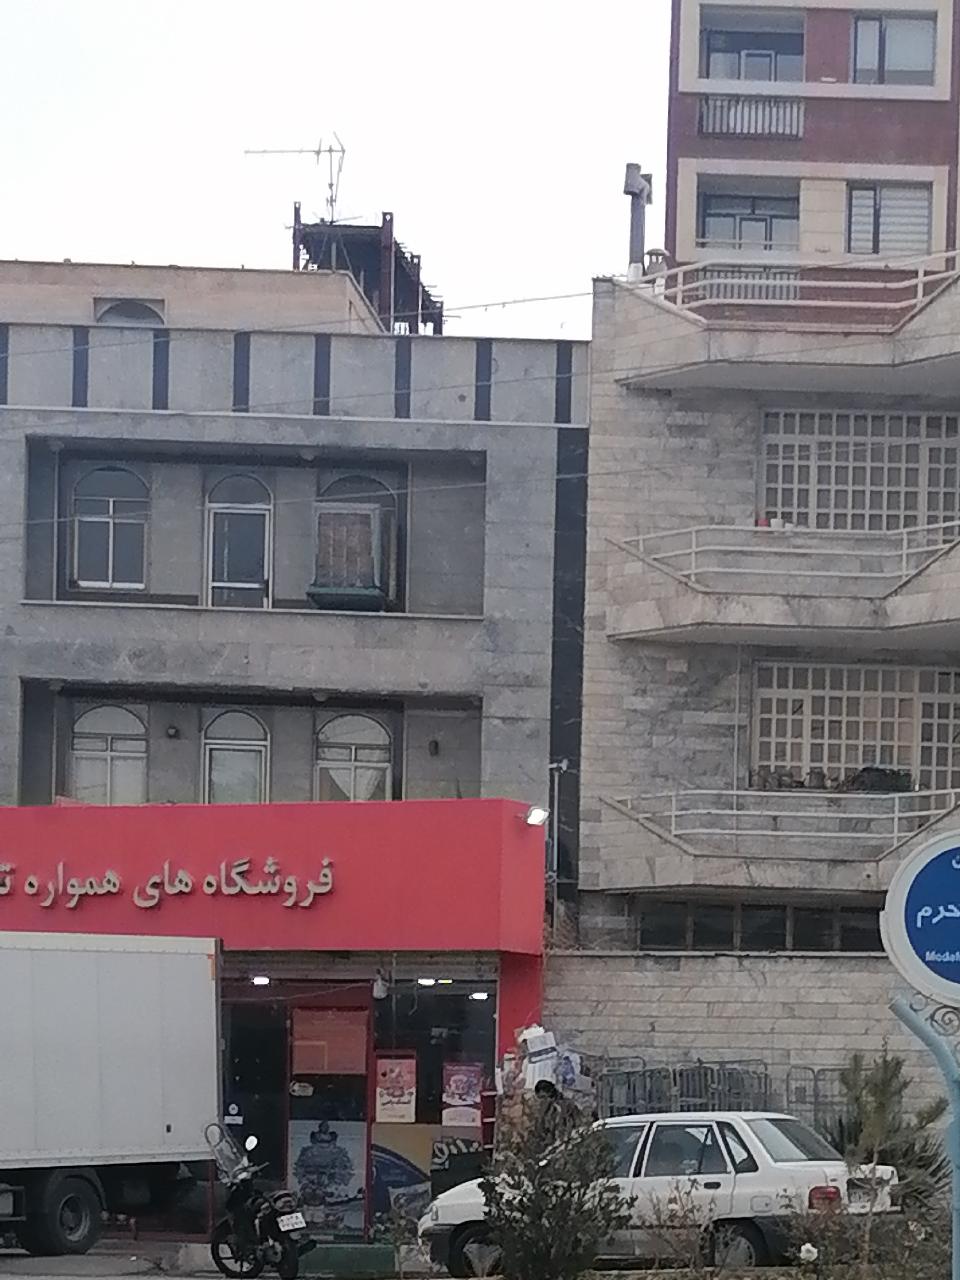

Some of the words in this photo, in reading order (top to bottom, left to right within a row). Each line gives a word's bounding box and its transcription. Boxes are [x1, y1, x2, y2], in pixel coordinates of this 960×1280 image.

[23, 861, 121, 908] همواره
[132, 859, 193, 908] های
[202, 856, 334, 908] فروشگاه
[916, 904, 960, 928] حرم
